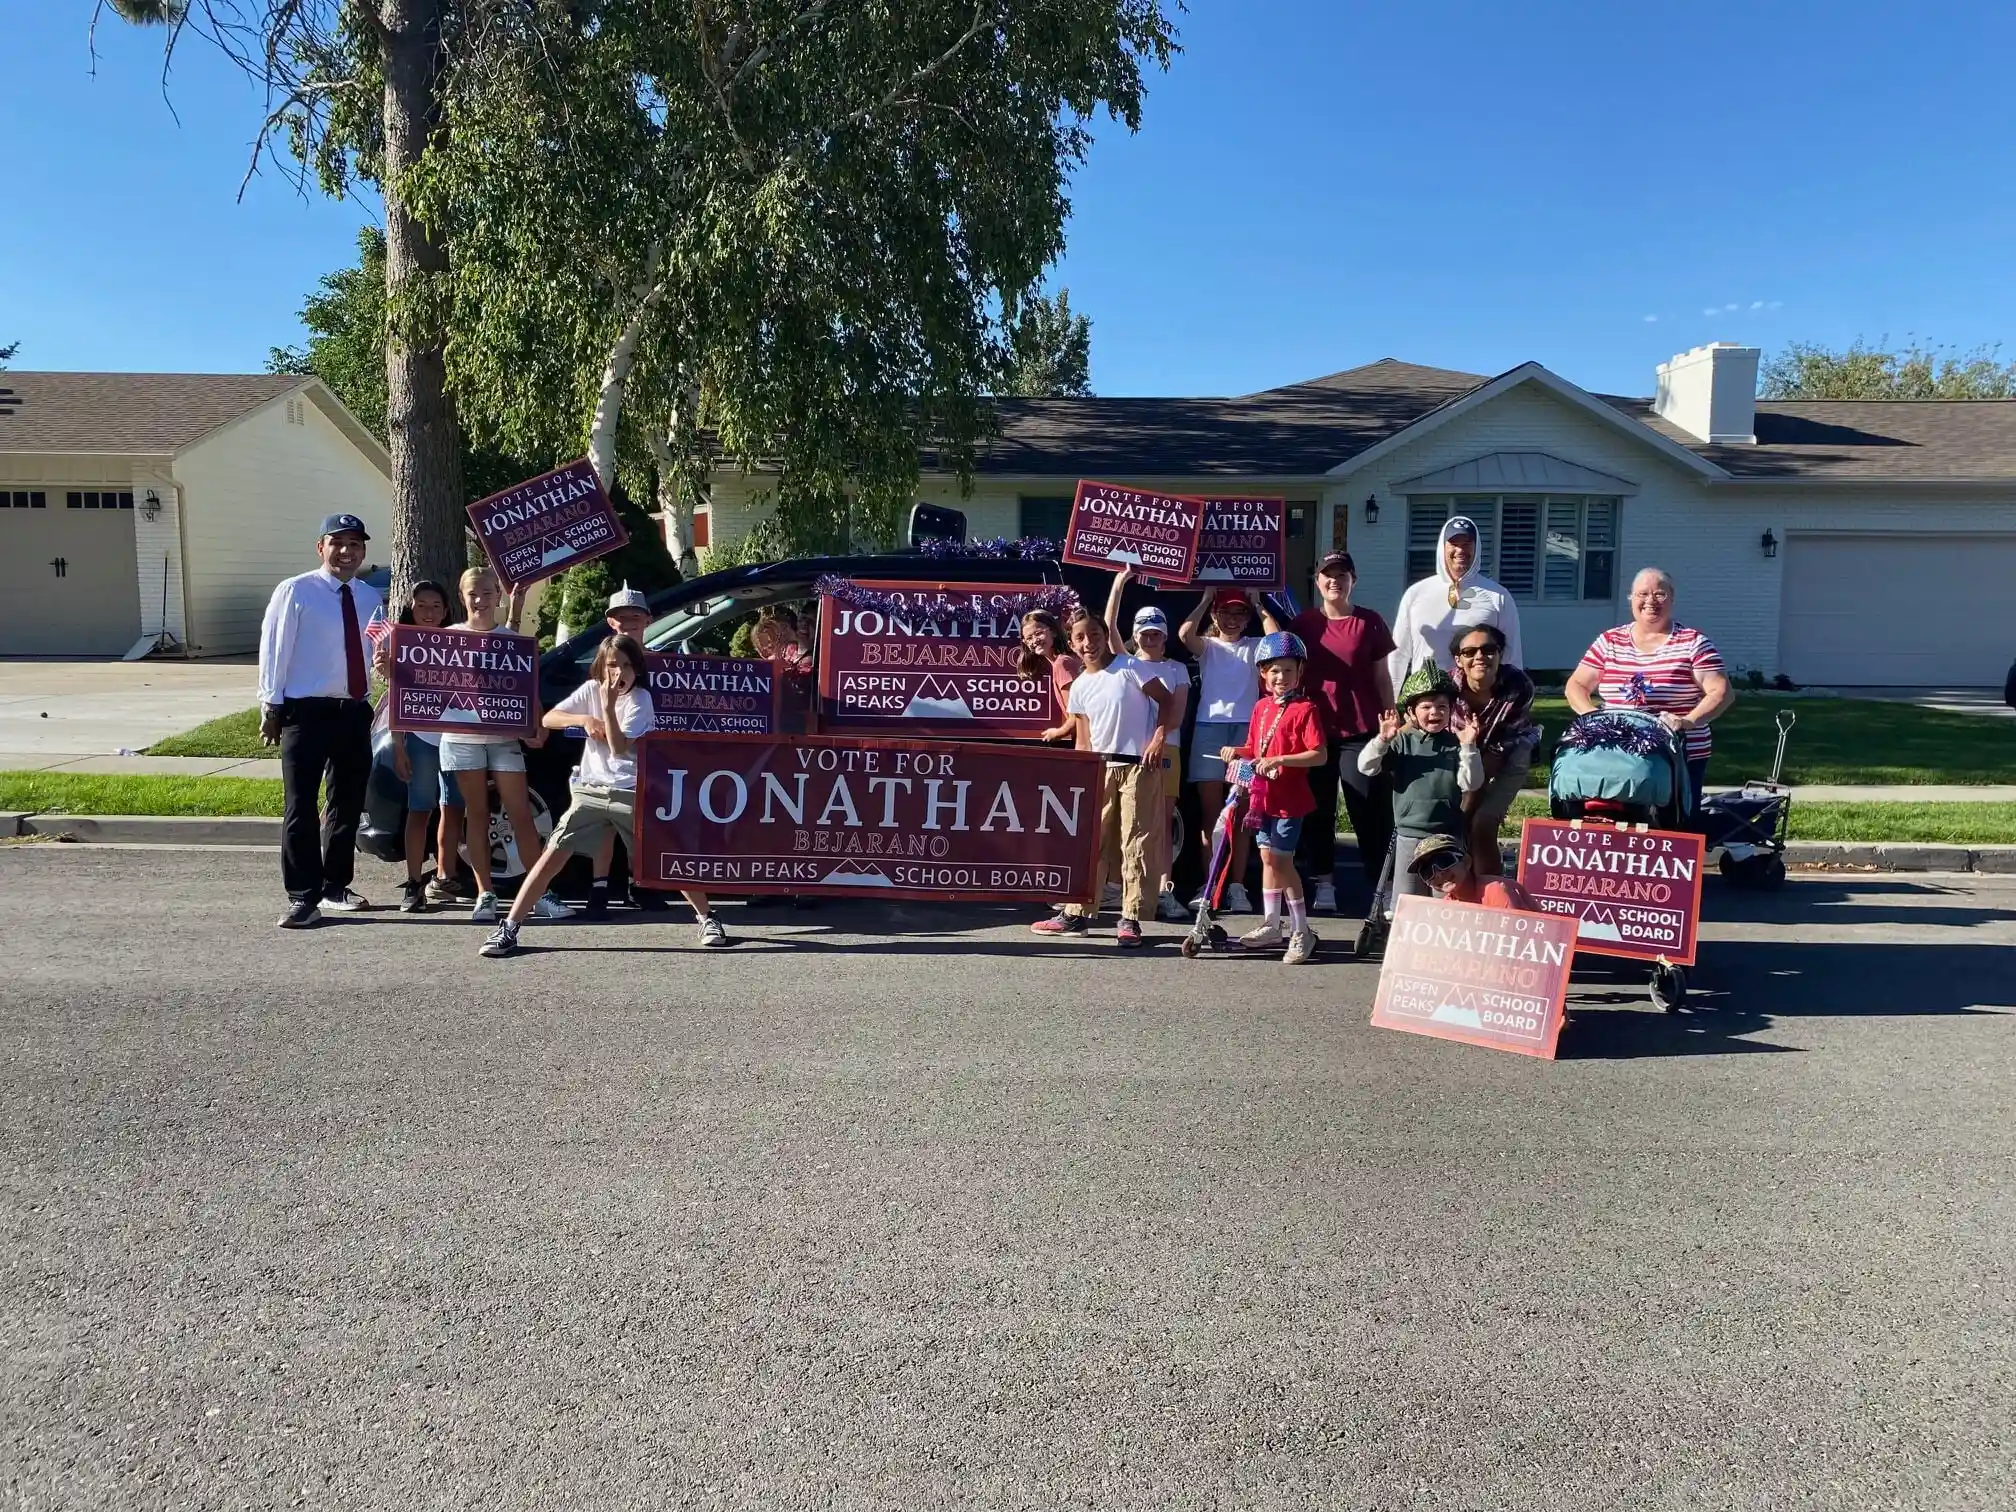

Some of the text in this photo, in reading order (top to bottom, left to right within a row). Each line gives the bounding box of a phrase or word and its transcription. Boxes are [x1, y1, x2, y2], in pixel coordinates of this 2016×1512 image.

[490, 470, 575, 511] VOTE FOR
[1099, 489, 1184, 510] VOTE FOR
[481, 475, 598, 536] JONATHAN
[1079, 497, 1198, 529] JONATHAN
[1205, 501, 1264, 511] TE FOR
[502, 500, 591, 547] BEJARANO
[564, 516, 607, 539] SCHOOL
[1090, 516, 1179, 542] BEJARANO
[1200, 513, 1280, 531] ATHAN
[571, 526, 608, 548] BOARD
[1078, 532, 1112, 546] ASPEN
[1199, 534, 1266, 549] JARANO
[504, 545, 537, 567] ASPEN
[1078, 542, 1110, 555] PEAKS
[1141, 543, 1183, 558] SCHOOL
[509, 556, 541, 575] PEAKS
[1143, 554, 1179, 567] BOARD
[1231, 556, 1272, 565] SCHOOL
[1233, 567, 1270, 576] BOARD
[834, 611, 1021, 639] JONATHA
[417, 633, 515, 650] VOTE FOR
[396, 645, 533, 673] JONATHAN
[662, 659, 754, 673] VOTE FOR
[413, 668, 517, 691] BEJARANO
[648, 672, 772, 693] JONATHAN
[843, 676, 906, 691] ASPEN
[966, 679, 1047, 694] SCHOOL
[403, 692, 442, 703] ASPEN
[477, 697, 526, 709] SCHOOL
[660, 693, 757, 711] BEJARANO
[845, 695, 905, 709] PEAKS
[972, 697, 1041, 712] BOARD
[404, 705, 441, 716] PEAKS
[481, 709, 522, 720] BOARD
[654, 715, 687, 725] ASPEN
[720, 717, 765, 728] SCHOOL
[796, 748, 956, 776] VOTE FOR
[655, 769, 1085, 837] JONATHAN
[793, 829, 950, 857] BEJARANO
[1552, 829, 1673, 852] VOTE FOR
[1526, 844, 1696, 881] JONATHAN
[669, 860, 1062, 888] ASPEN PEAKS SCHOOL BOARD
[1544, 872, 1671, 903] BEJARANO
[1540, 899, 1576, 914] SPEN
[1424, 907, 1545, 935] VOTE FOR
[1618, 908, 1681, 927] SCHOOL
[1622, 923, 1675, 941] BOARD
[1397, 919, 1568, 967] JONATHAN
[1410, 948, 1538, 989] BEJARANO
[1393, 978, 1438, 997] ASPEN
[1393, 995, 1434, 1012] PEAKS
[1482, 993, 1544, 1016] SCHOOL
[1483, 1010, 1537, 1031] BOARD
